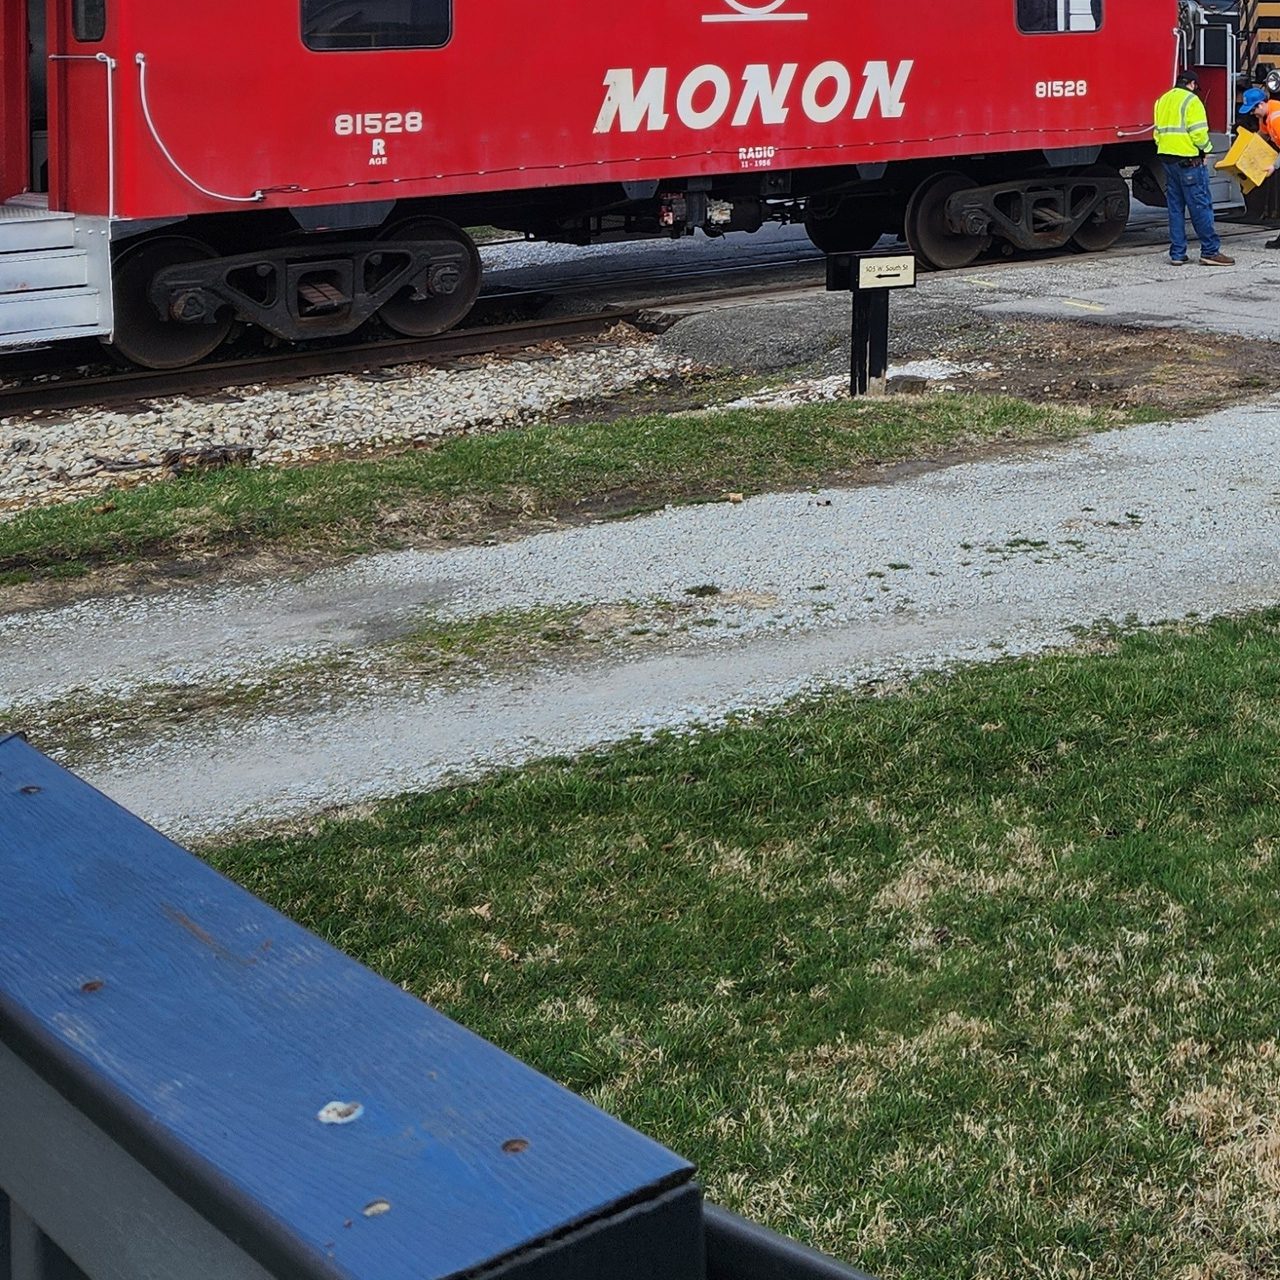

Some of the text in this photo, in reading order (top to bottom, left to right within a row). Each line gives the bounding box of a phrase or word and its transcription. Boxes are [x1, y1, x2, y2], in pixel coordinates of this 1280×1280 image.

[592, 59, 914, 134] MONON
[1035, 80, 1087, 98] 81528
[335, 111, 423, 136] 81528
[372, 138, 386, 156] R
[738, 146, 775, 160] RADIO
[885, 264, 902, 272] South
